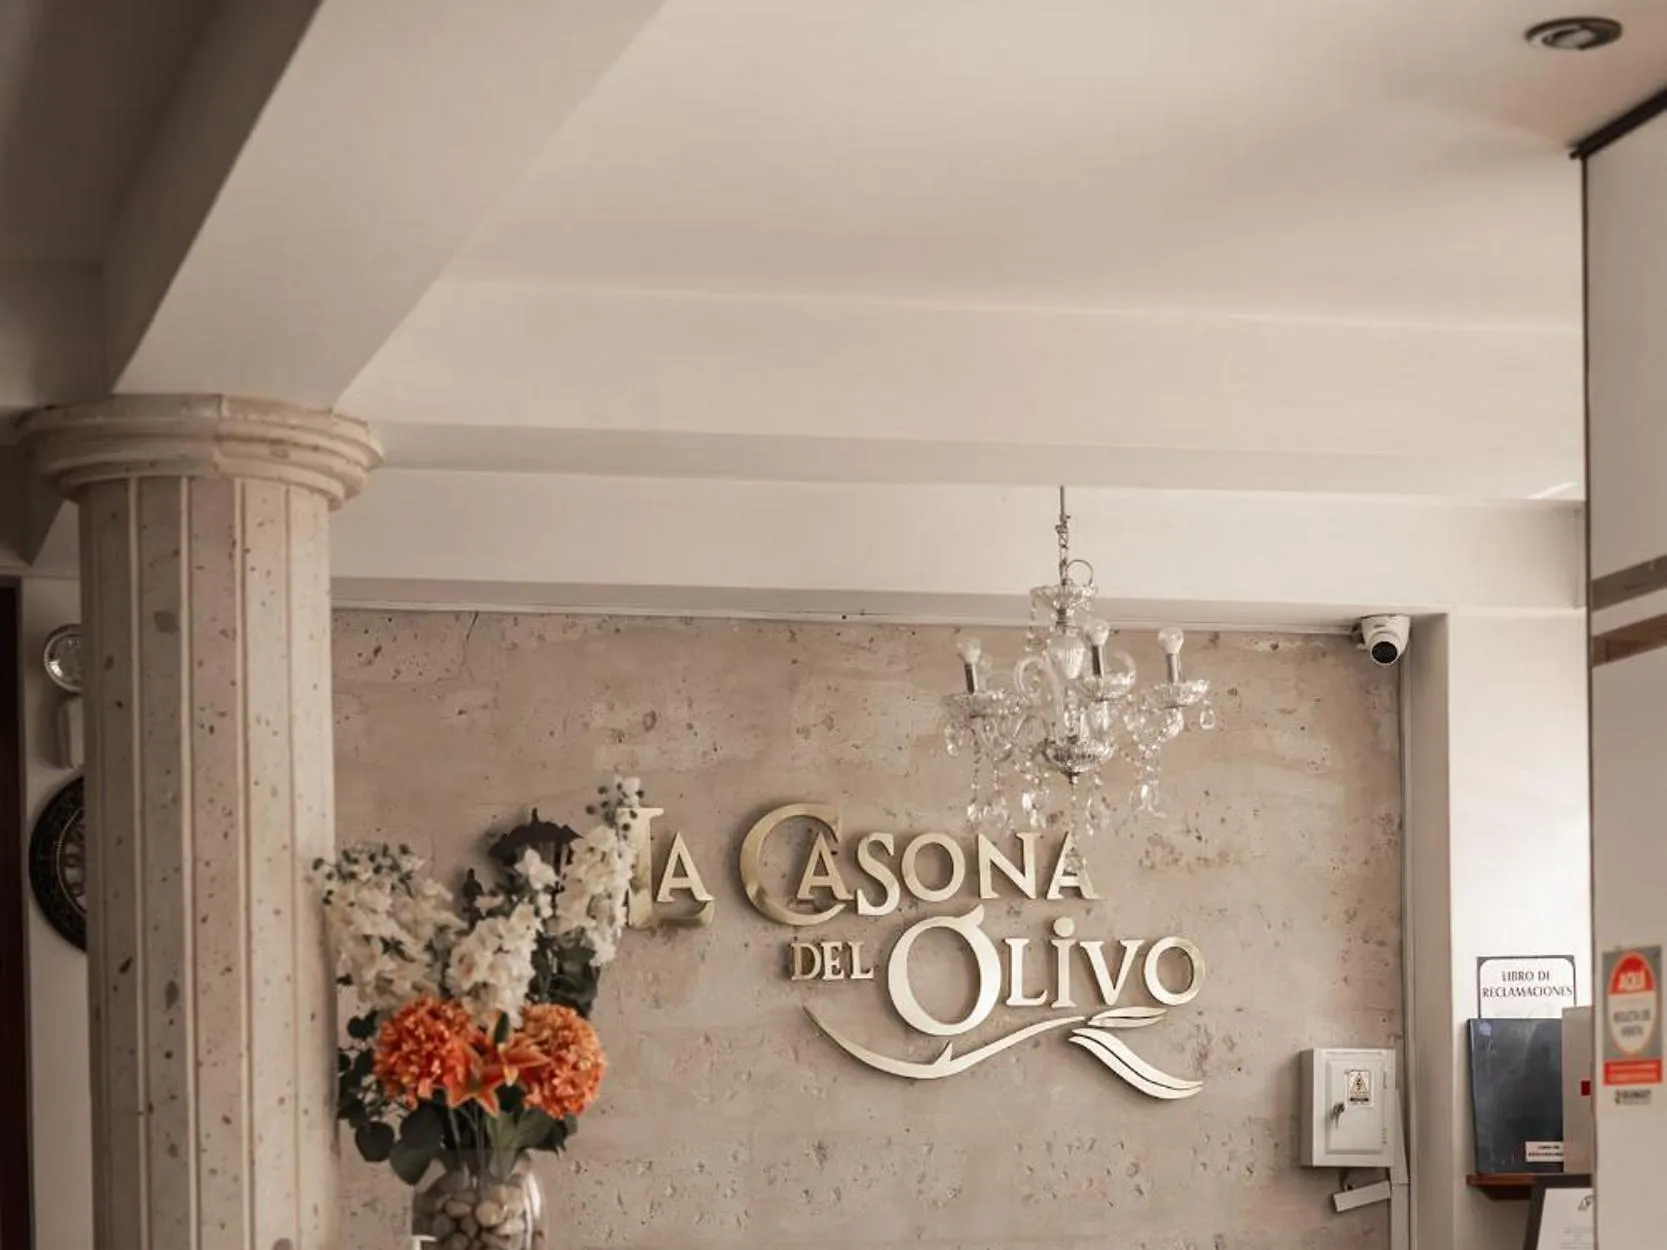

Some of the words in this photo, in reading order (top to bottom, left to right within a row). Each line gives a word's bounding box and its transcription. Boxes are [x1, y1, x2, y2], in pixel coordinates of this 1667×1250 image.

[739, 802, 1098, 926] CASONA
[791, 941, 875, 982] DEL
[1502, 970, 1534, 982] LIBRO
[1482, 985, 1573, 998] RECLAMACIONES
